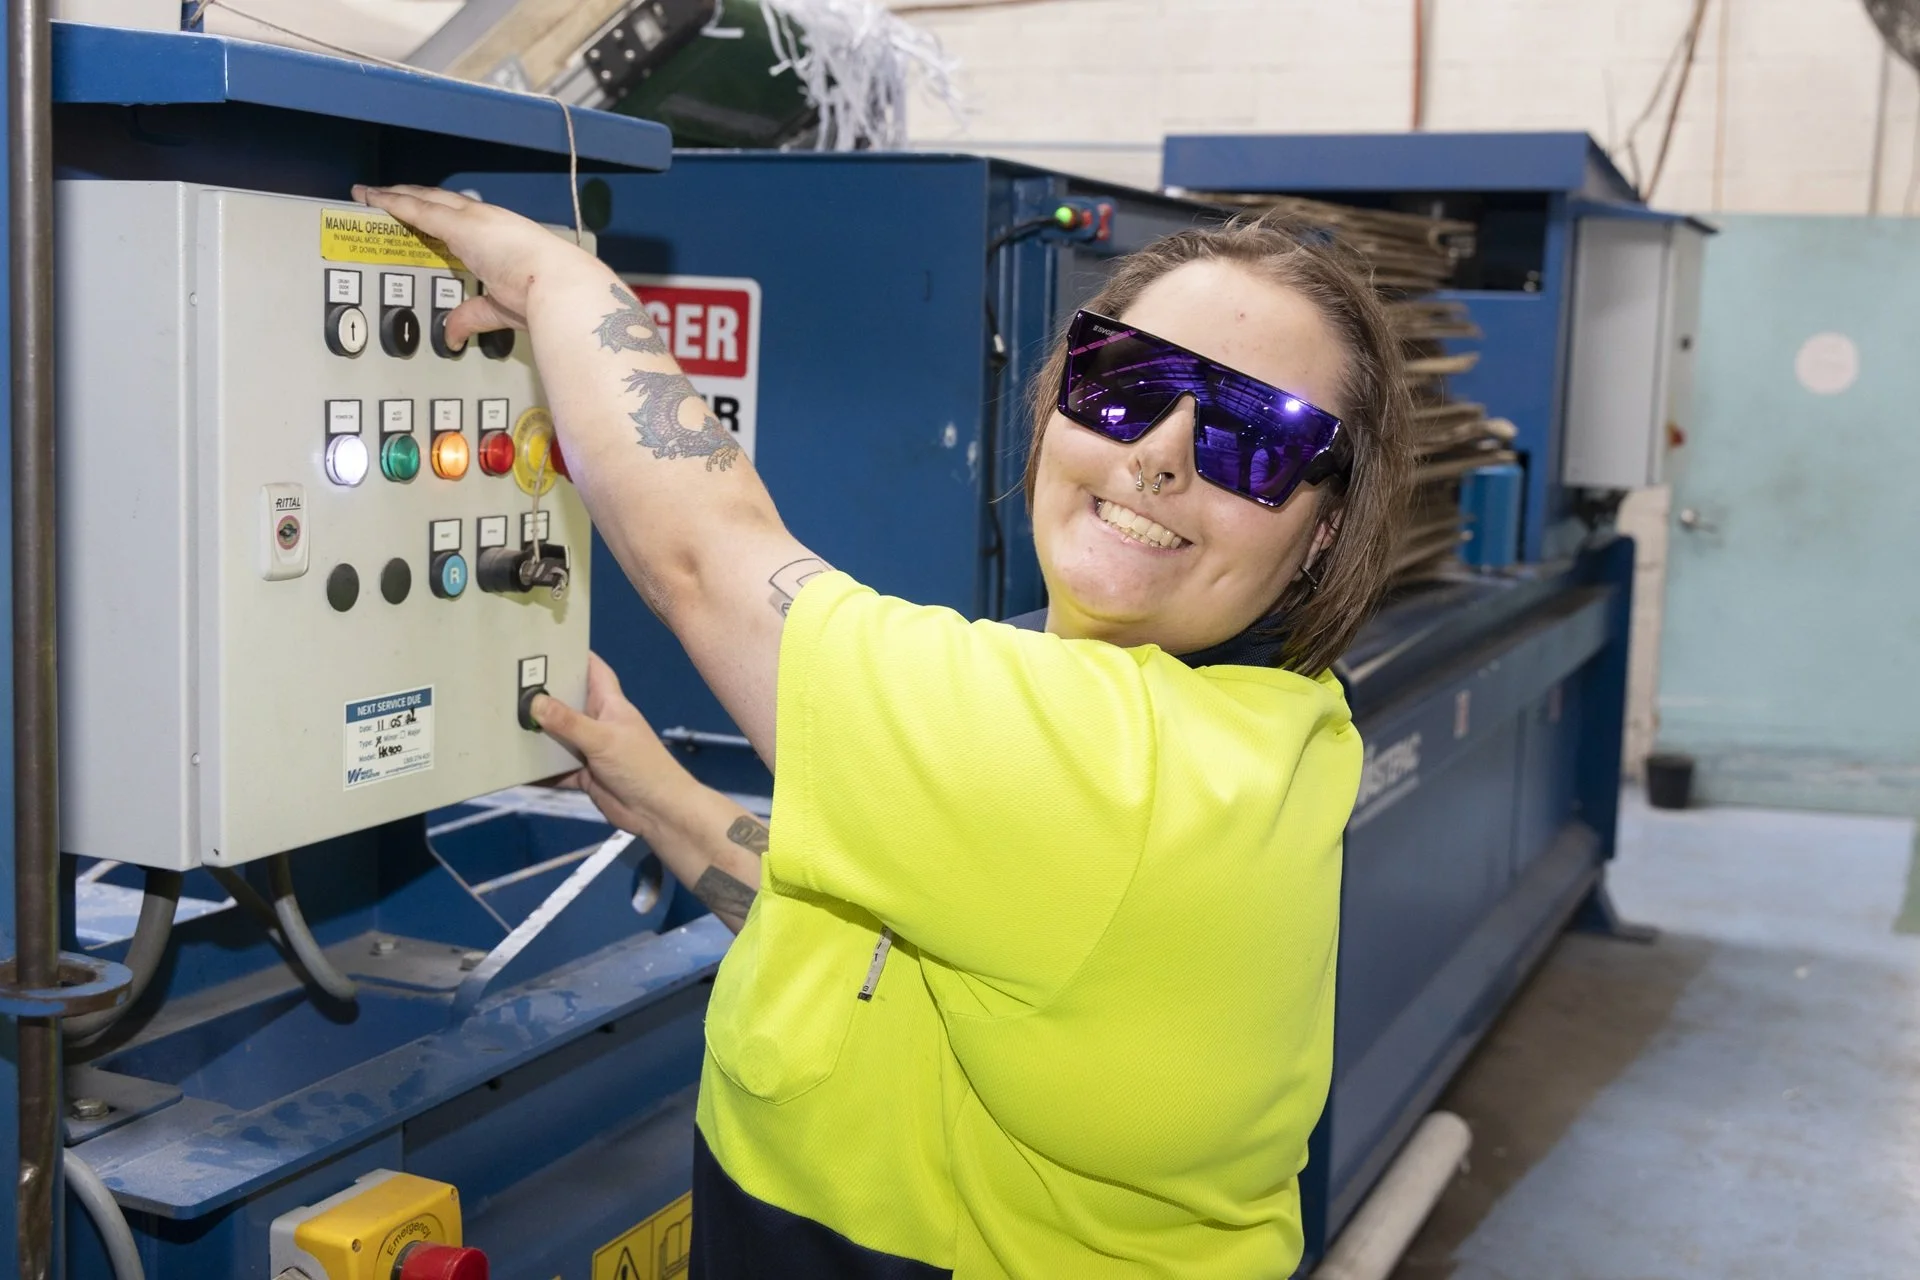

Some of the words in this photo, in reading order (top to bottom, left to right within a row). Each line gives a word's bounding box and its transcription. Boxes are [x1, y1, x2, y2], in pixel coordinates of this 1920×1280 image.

[325, 216, 363, 233] MANUAL
[333, 233, 340, 241] IN
[340, 234, 364, 243] MANUAL
[383, 238, 402, 246] PRESS
[402, 239, 414, 248] AND
[644, 301, 739, 362] GER
[275, 497, 301, 508] RITTAL
[450, 567, 460, 585] R
[357, 703, 377, 717] NEXT
[377, 697, 406, 712] SERVICE
[406, 693, 422, 707] DUE
[386, 1221, 432, 1256] Emergency
